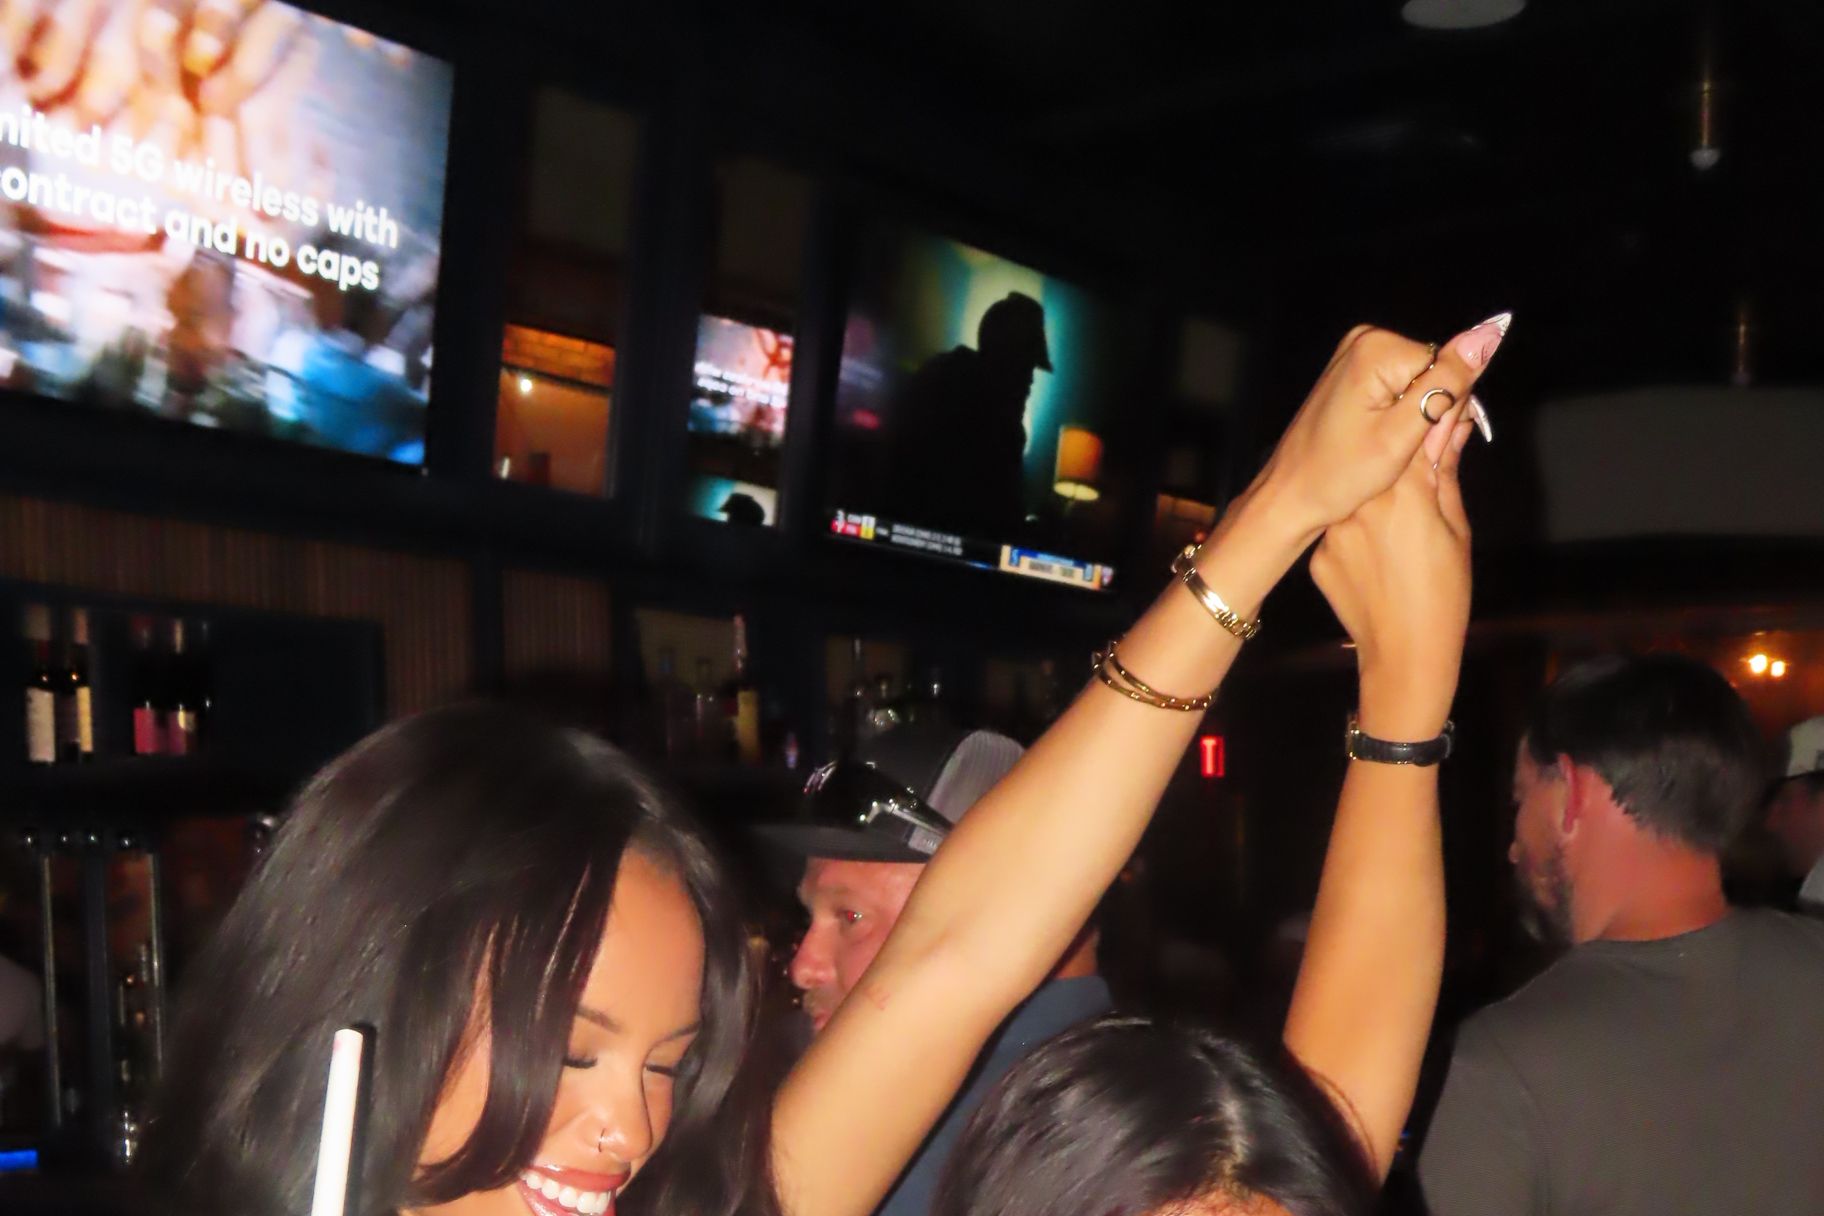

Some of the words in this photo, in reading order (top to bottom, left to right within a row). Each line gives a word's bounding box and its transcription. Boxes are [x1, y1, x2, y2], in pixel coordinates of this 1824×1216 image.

[0, 165, 157, 235] ontract
[164, 209, 238, 255] and
[245, 229, 290, 268] no
[296, 244, 380, 291] caps
[110, 132, 164, 182] 5G
[172, 156, 319, 227] wireless
[326, 199, 398, 248] with
